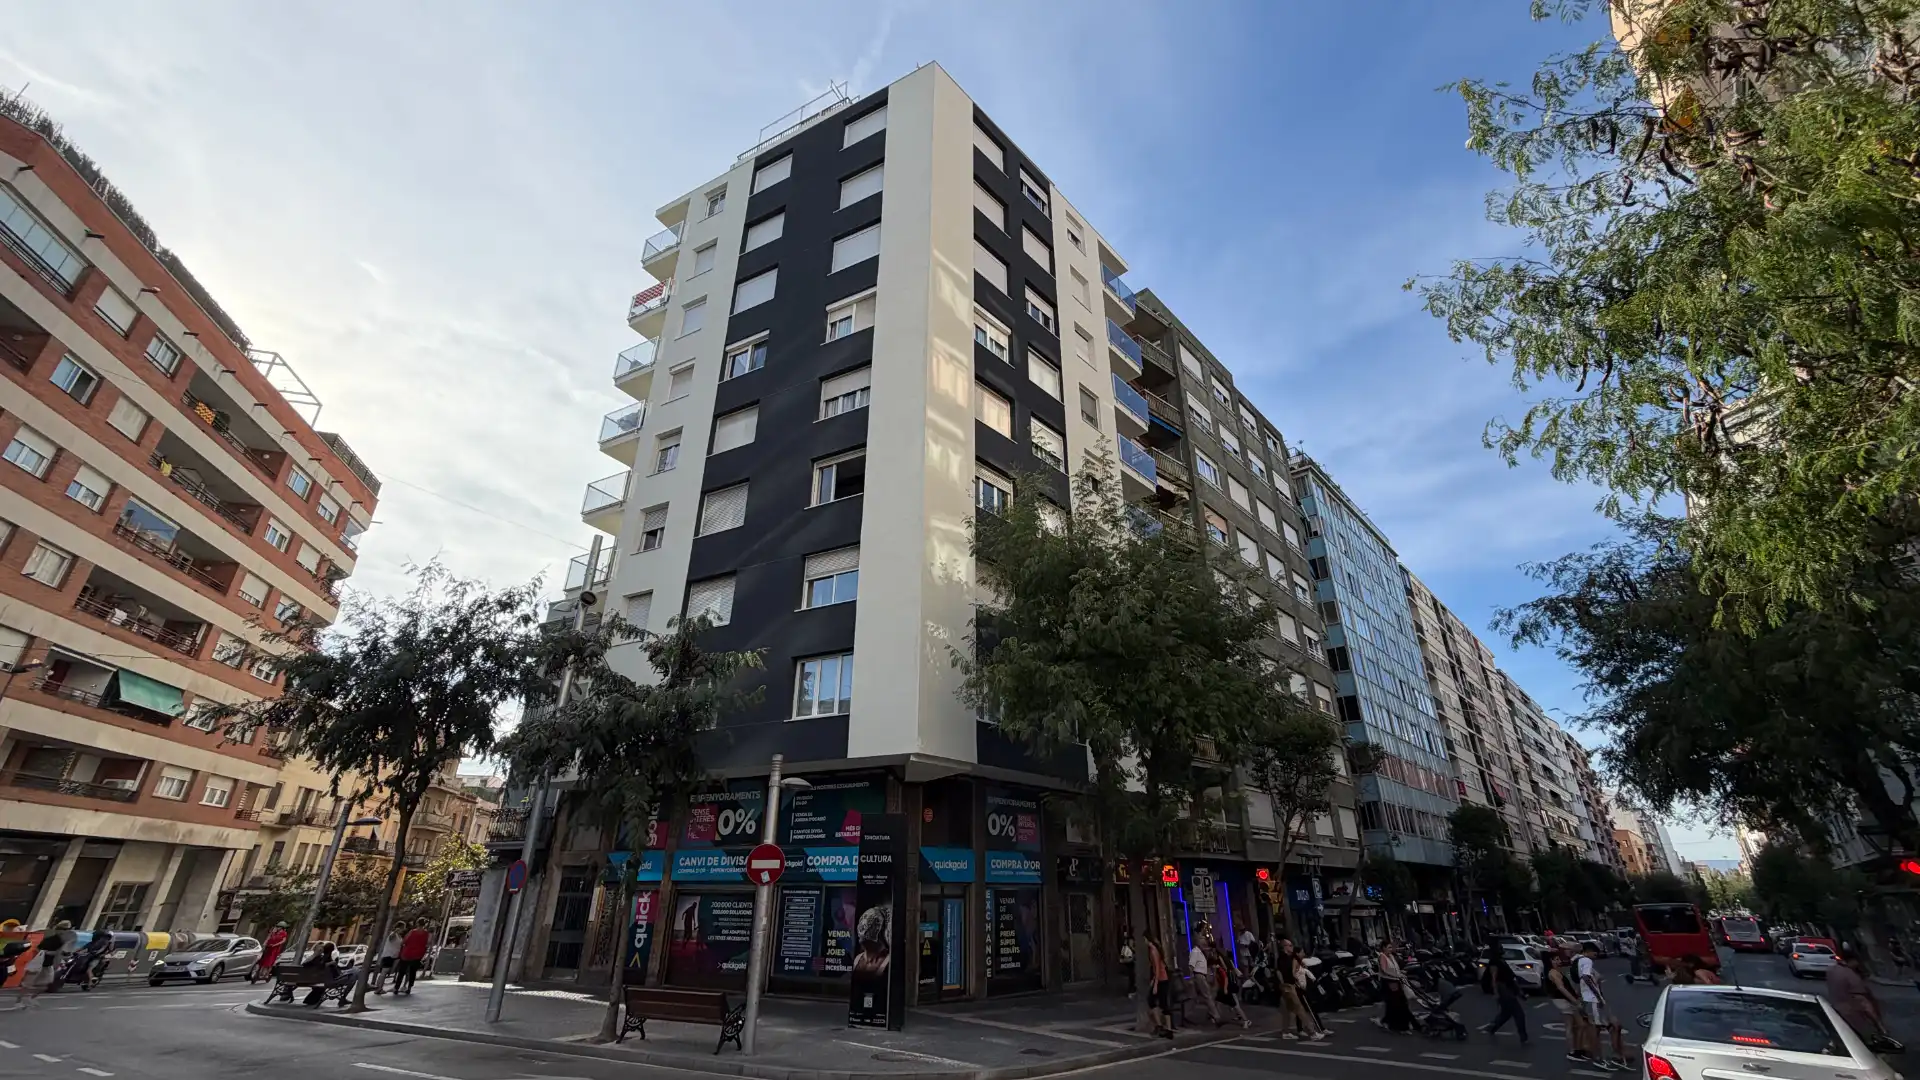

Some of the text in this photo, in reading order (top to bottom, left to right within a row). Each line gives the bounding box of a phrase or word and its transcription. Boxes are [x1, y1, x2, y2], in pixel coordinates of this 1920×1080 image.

[717, 808, 756, 836] 0%
[987, 812, 1016, 837] 0%
[679, 856, 706, 866] CANVI
[706, 856, 720, 866] DE
[806, 855, 850, 866] COMPRA
[860, 854, 893, 863] CULTURA
[990, 858, 1041, 870] COMPRA D'OR
[934, 859, 968, 871] quickgold
[634, 891, 652, 949] quick
[827, 929, 851, 938] VENDA
[985, 890, 993, 978] EXCHANGE
[826, 938, 837, 947] DE
[826, 947, 846, 957] JOIES
